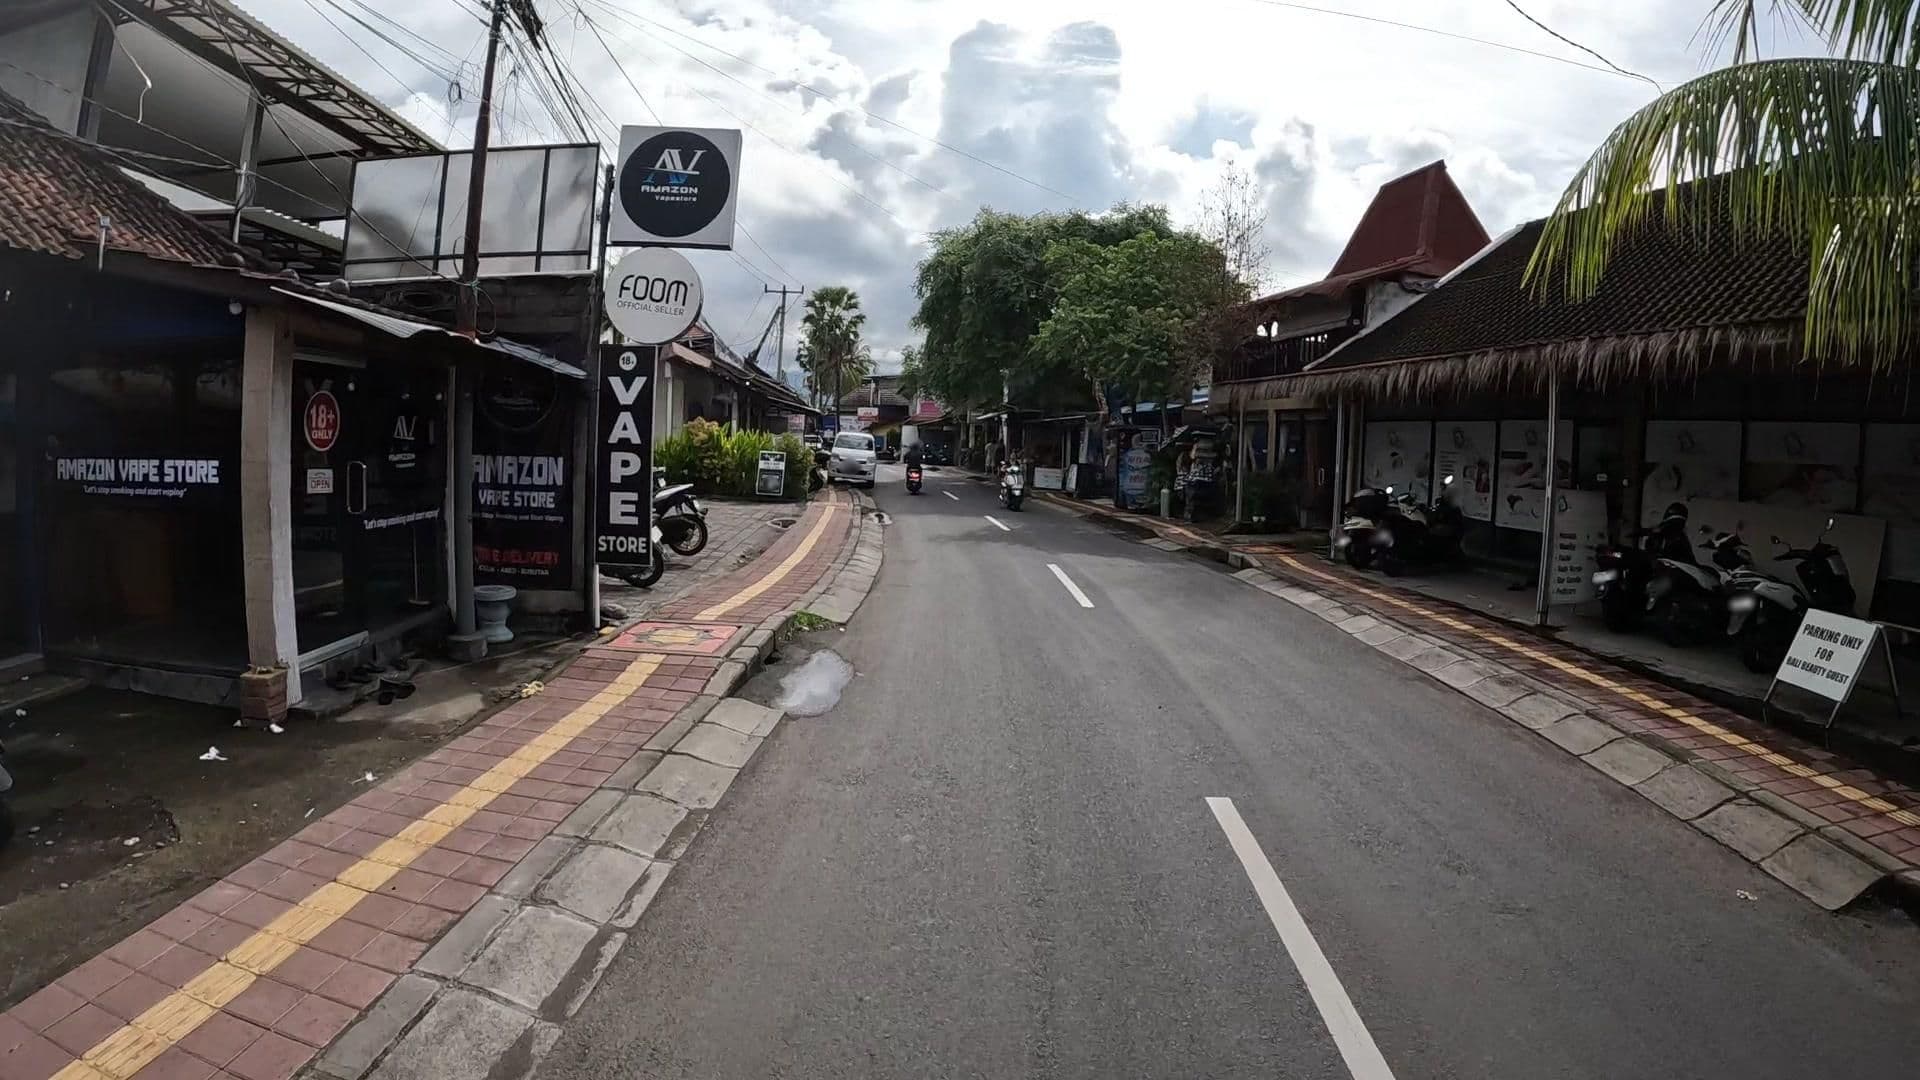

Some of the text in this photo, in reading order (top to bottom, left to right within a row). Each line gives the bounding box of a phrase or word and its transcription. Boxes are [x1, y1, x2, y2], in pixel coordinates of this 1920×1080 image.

[641, 185, 698, 194] AMAZON
[619, 275, 688, 306] FOOM
[617, 300, 684, 316] OFFICIAL SELLER
[310, 404, 336, 430] 18+
[311, 428, 333, 440] ONLY
[607, 376, 648, 525] VAPE
[56, 458, 220, 484] AMAZON VAPE STORE
[472, 454, 563, 486] AMAZON
[478, 489, 555, 508] VAPE STORE
[598, 535, 647, 553] STORE
[1803, 623, 1865, 650] PARKING ONLY
[1814, 646, 1835, 663] FOR
[1786, 656, 1850, 685] BALI BEAUTY GUEST
